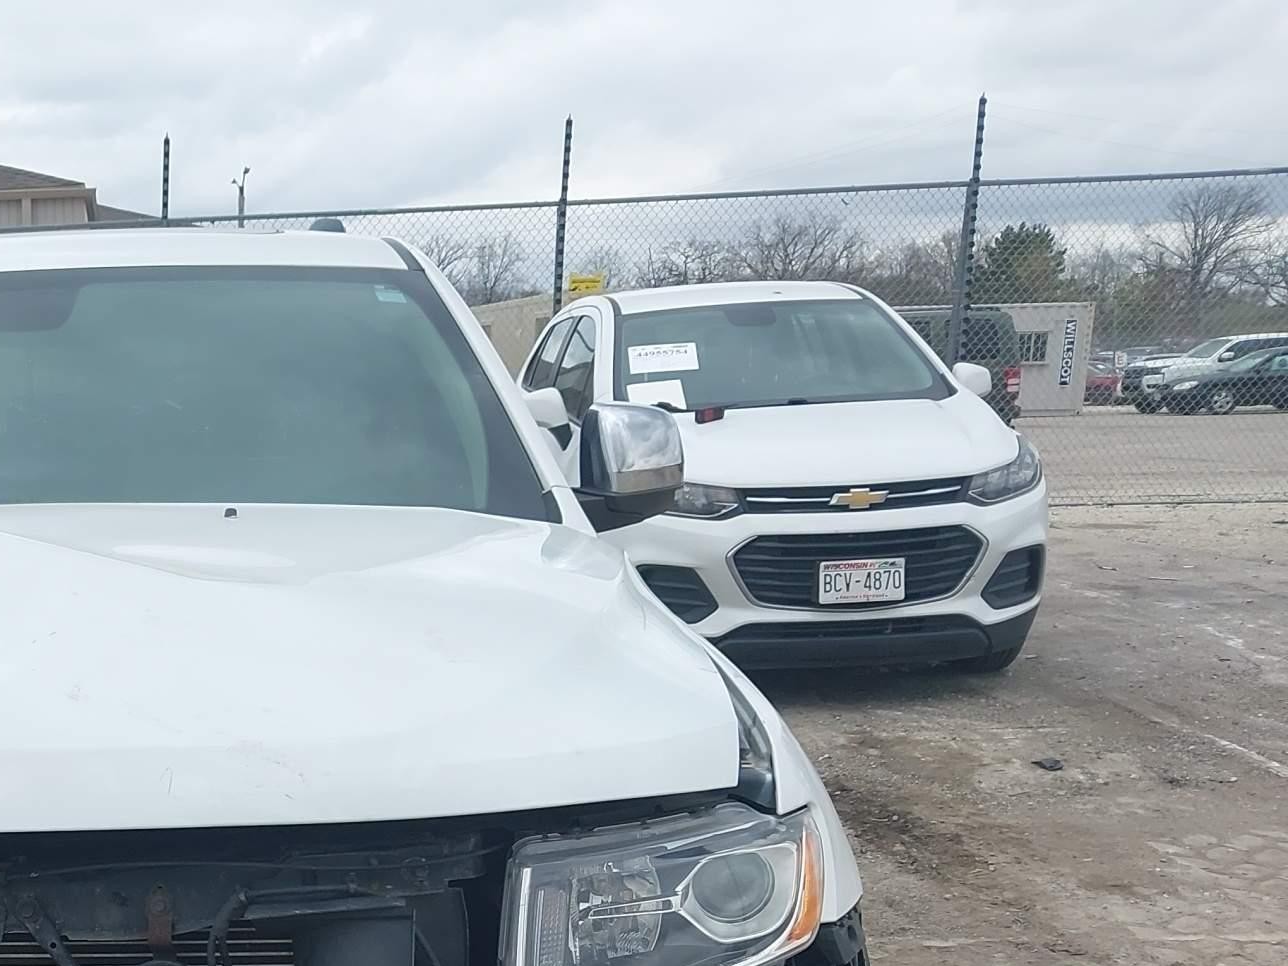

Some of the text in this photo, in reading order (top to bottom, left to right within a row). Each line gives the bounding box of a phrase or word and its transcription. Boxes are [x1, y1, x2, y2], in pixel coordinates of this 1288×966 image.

[1061, 321, 1077, 384] WILLSCOT
[823, 561, 868, 570] WISCONSIN
[823, 570, 902, 593] BCV-4870
